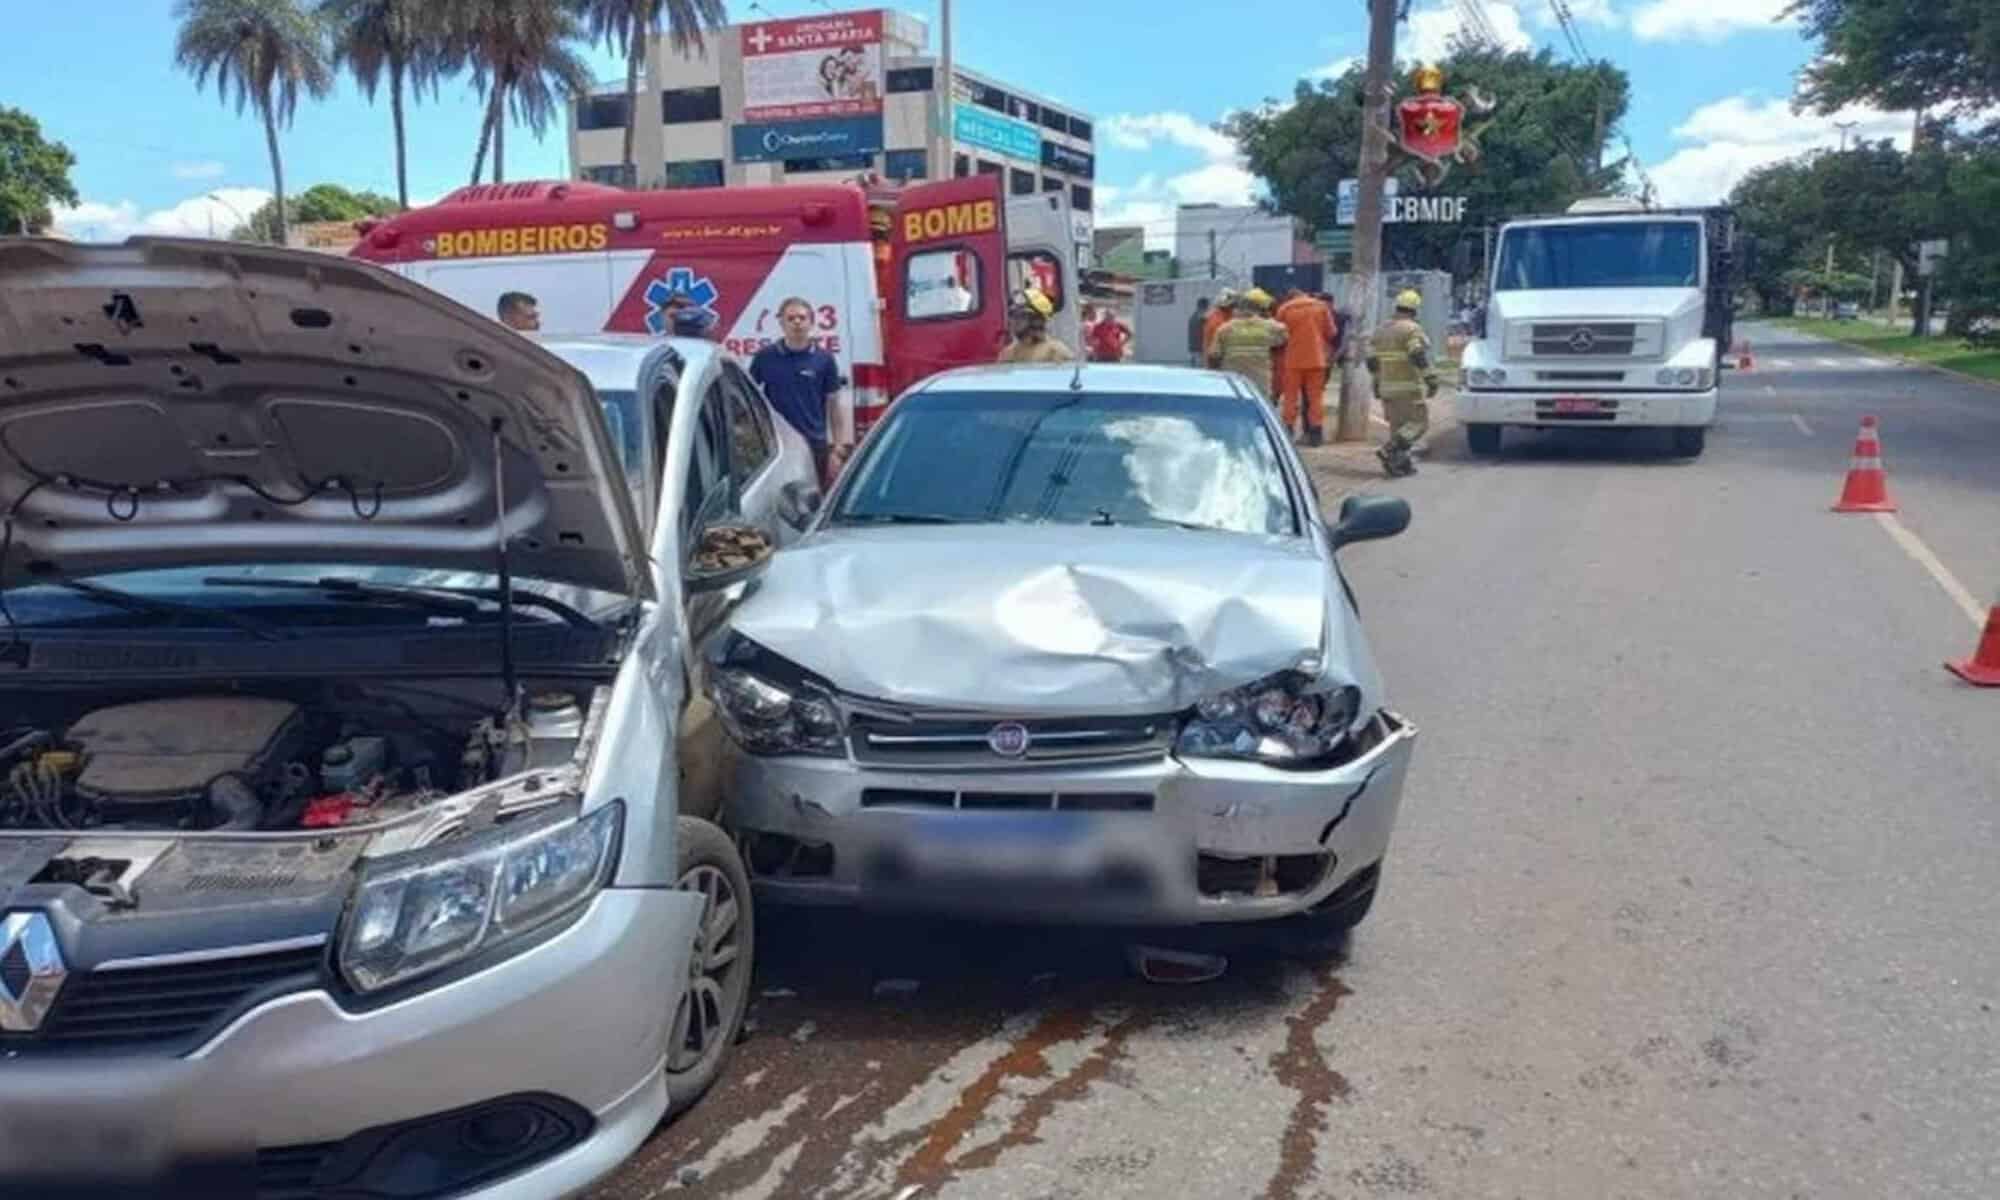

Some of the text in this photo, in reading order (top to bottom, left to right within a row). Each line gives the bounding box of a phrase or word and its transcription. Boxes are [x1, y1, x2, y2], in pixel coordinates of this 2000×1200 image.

[778, 27, 873, 48] SANTA MARIA
[904, 201, 996, 242] BOMB
[437, 224, 607, 257] BOMBEIROS
